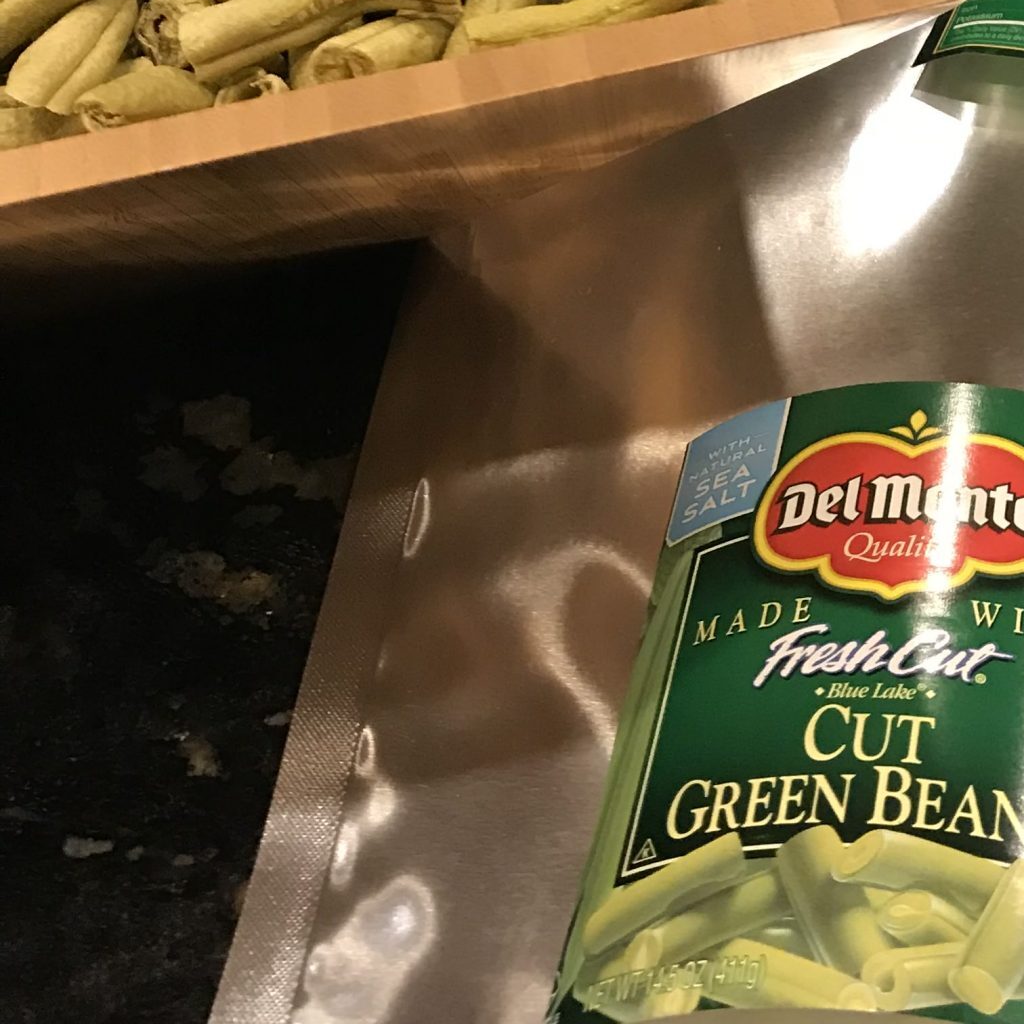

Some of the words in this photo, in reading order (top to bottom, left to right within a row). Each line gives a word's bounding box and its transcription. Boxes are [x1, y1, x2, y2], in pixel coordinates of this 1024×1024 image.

[689, 443, 767, 483] NATURAL
[709, 436, 751, 460] WITH
[681, 479, 757, 524] SALT
[694, 464, 751, 499] SEA
[778, 476, 861, 530] Del
[843, 532, 946, 564] Quali
[692, 596, 813, 647] MADE
[827, 682, 868, 699] Blue
[803, 703, 936, 764] CUT
[666, 773, 856, 840] GREEN
